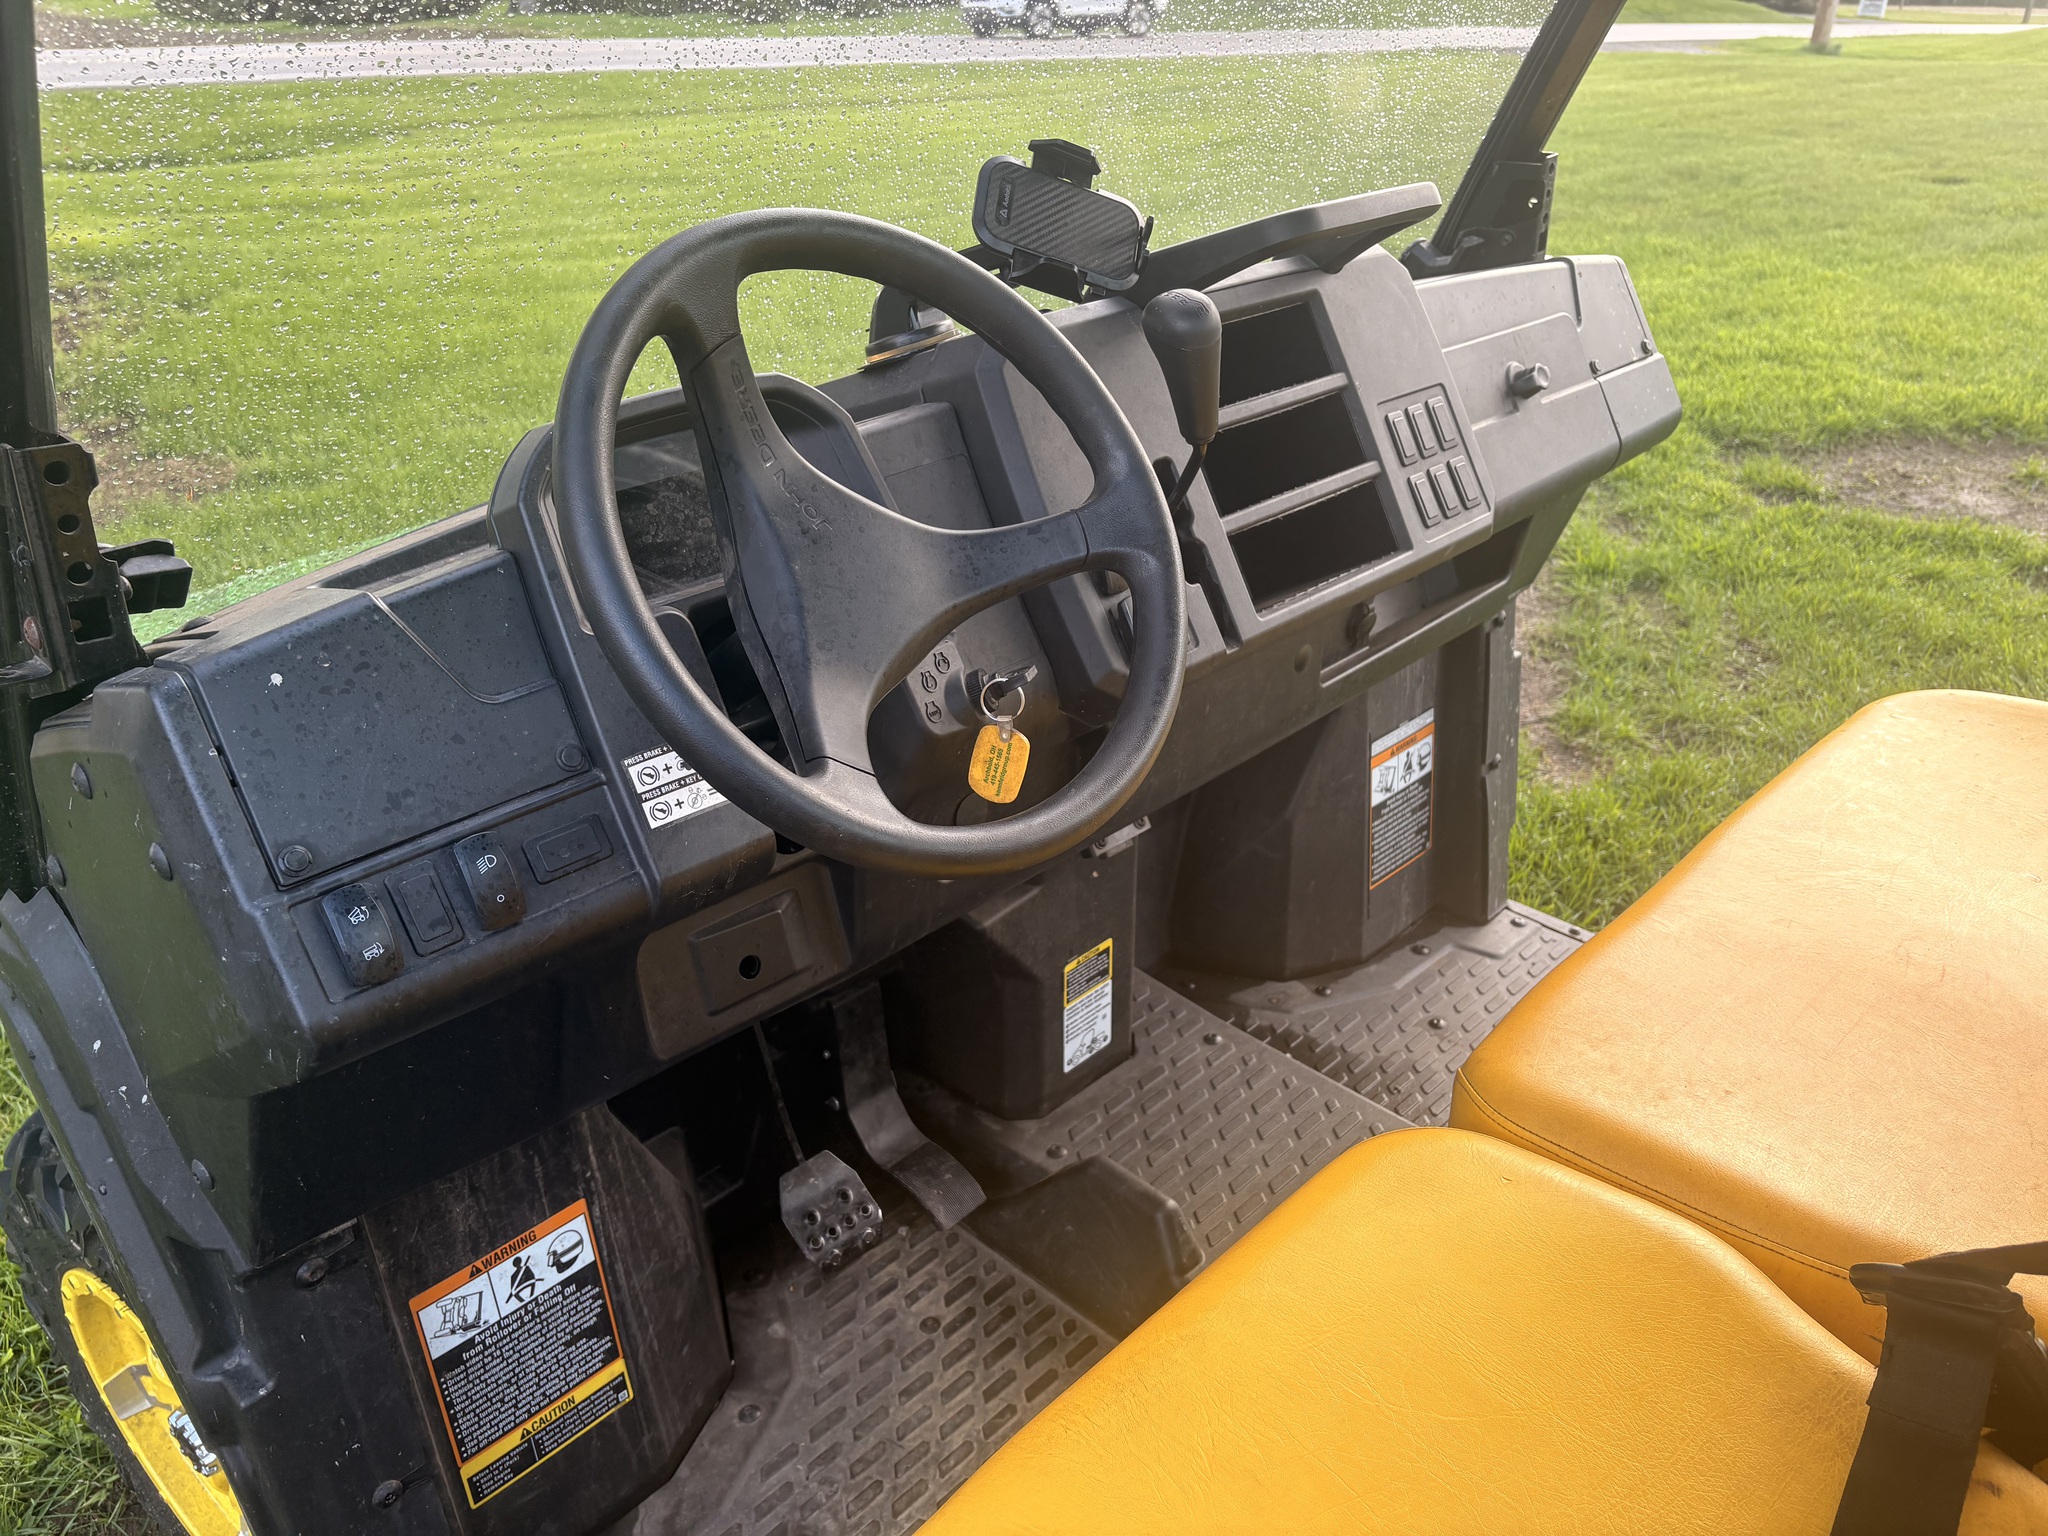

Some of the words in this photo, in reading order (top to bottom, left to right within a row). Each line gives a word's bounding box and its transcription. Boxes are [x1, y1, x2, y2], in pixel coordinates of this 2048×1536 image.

[731, 367, 777, 468] DEERE
[772, 468, 833, 531] JOHN
[624, 754, 644, 766] PRESS
[644, 748, 662, 759] BRAKE
[983, 756, 996, 784] Archbold,
[990, 745, 997, 754] OH
[641, 788, 661, 800] PRESS
[661, 781, 680, 793] BRAKE
[686, 775, 697, 784] KEY
[481, 1231, 536, 1269] WARNING
[445, 1365, 465, 1380] Watch
[466, 1354, 483, 1367] video
[484, 1345, 496, 1356] and
[496, 1336, 511, 1348] read
[541, 1303, 562, 1320] manual
[562, 1292, 581, 1306] before
[463, 1344, 484, 1360] from
[485, 1320, 521, 1346] Rollover
[522, 1313, 532, 1323] or
[534, 1294, 563, 1316] Falling
[564, 1284, 576, 1296] Off
[475, 1323, 499, 1344] Avoid
[500, 1308, 525, 1327] Injury
[527, 1301, 537, 1311] or
[538, 1285, 562, 1304] Death
[447, 1372, 466, 1387] Driver
[467, 1361, 483, 1374] must
[502, 1339, 518, 1353] years
[519, 1332, 529, 1341] old
[529, 1324, 542, 1335] with
[548, 1310, 562, 1323] valid
[562, 1300, 579, 1314] driver
[449, 1378, 467, 1393] Never
[468, 1368, 484, 1381] drive
[485, 1356, 502, 1370] under
[503, 1350, 513, 1359] the
[532, 1396, 575, 1432] CAUTION
